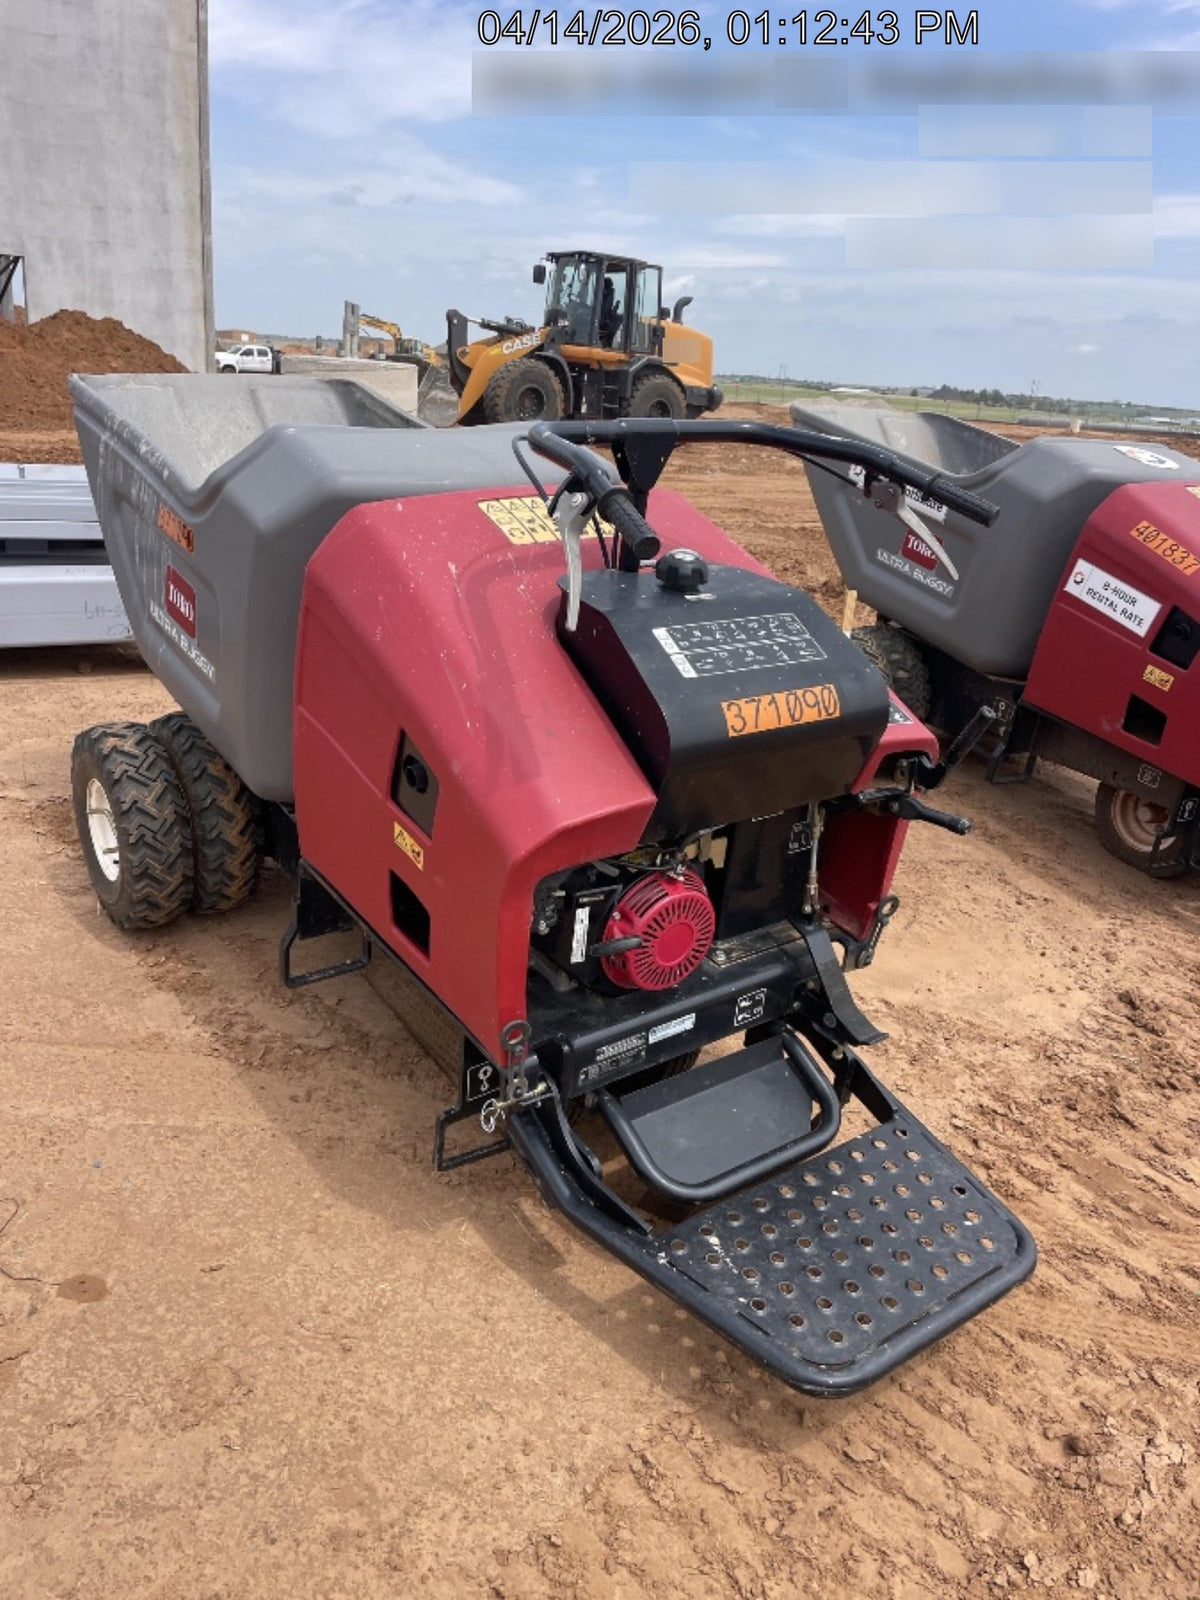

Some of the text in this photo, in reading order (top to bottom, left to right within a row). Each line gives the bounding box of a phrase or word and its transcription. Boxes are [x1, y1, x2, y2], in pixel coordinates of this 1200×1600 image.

[502, 331, 541, 354] CASE
[1135, 525, 1200, 572] 401837
[877, 548, 955, 599] ULTRA BUGGY
[1085, 587, 1145, 629] RENTAL RATE
[726, 684, 838, 734] 371090
